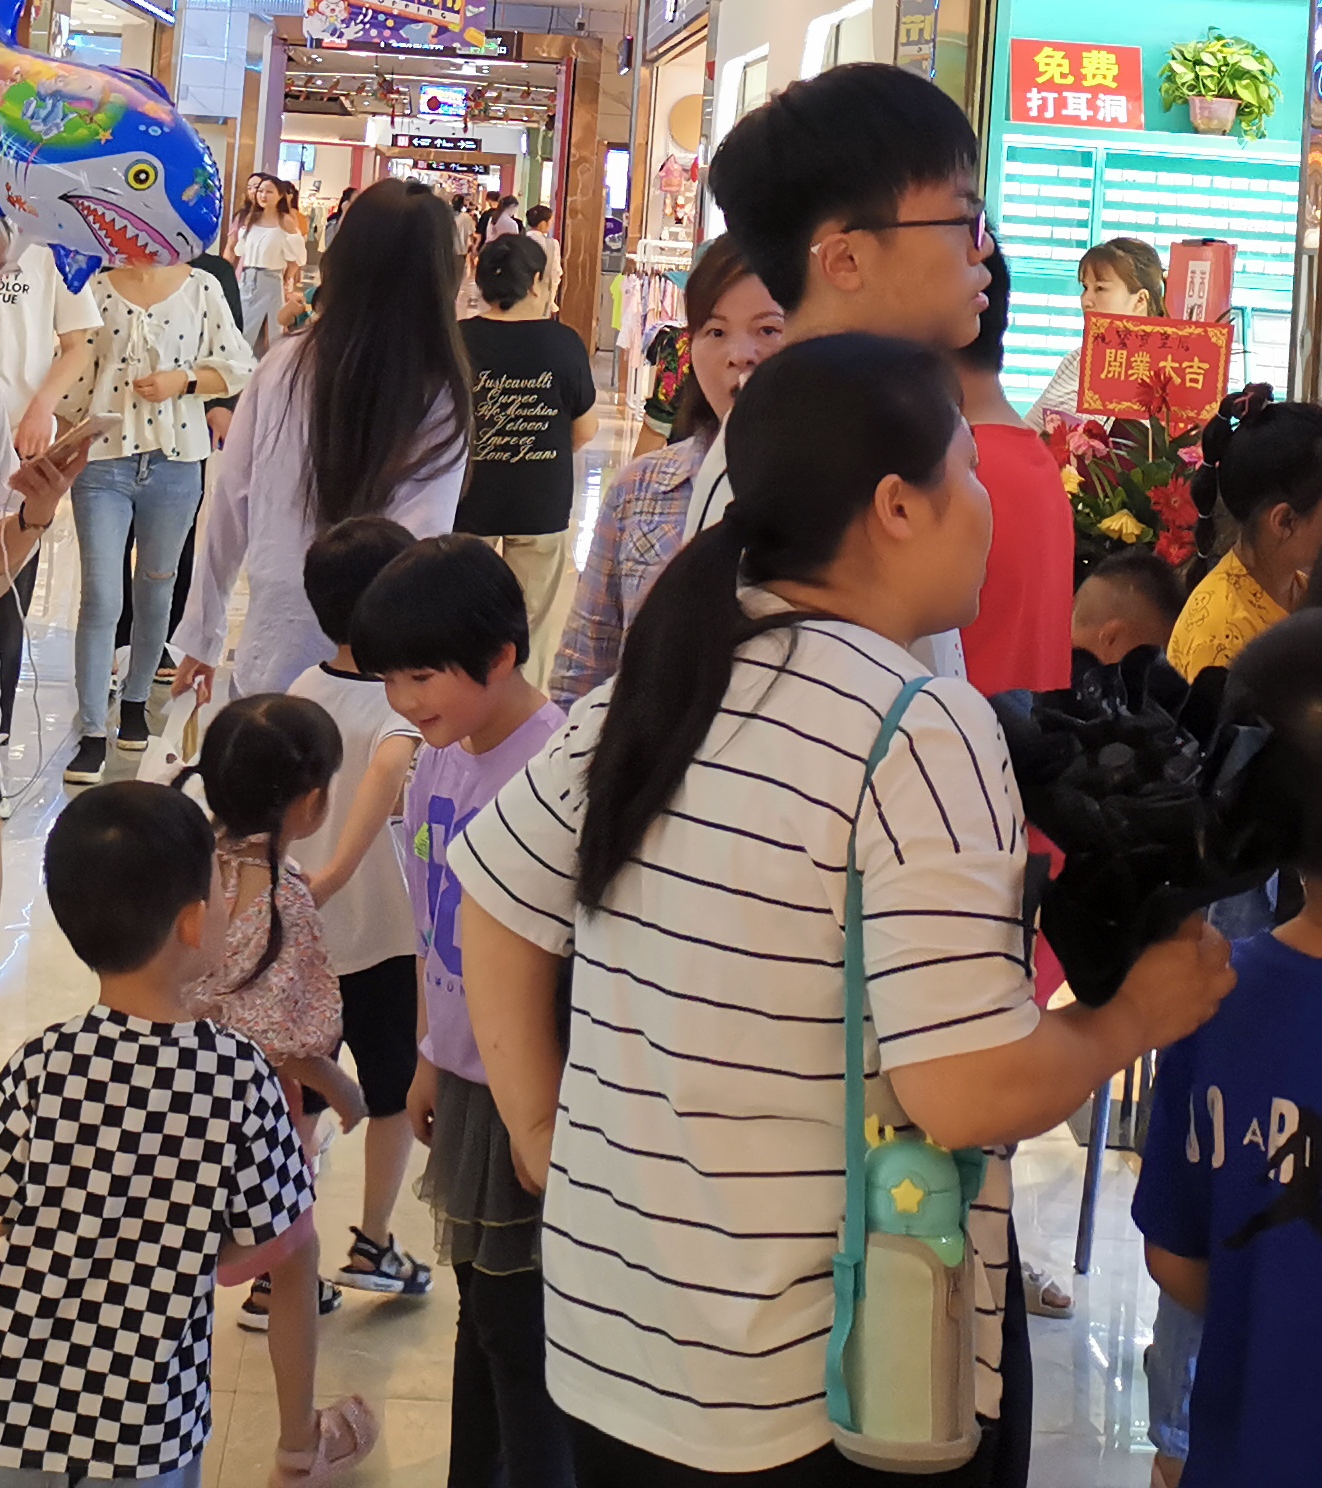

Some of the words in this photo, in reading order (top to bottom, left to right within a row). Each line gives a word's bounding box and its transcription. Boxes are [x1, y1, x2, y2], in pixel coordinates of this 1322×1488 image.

[1034, 46, 1120, 89] 免费
[1026, 88, 1129, 123] 打耳洞
